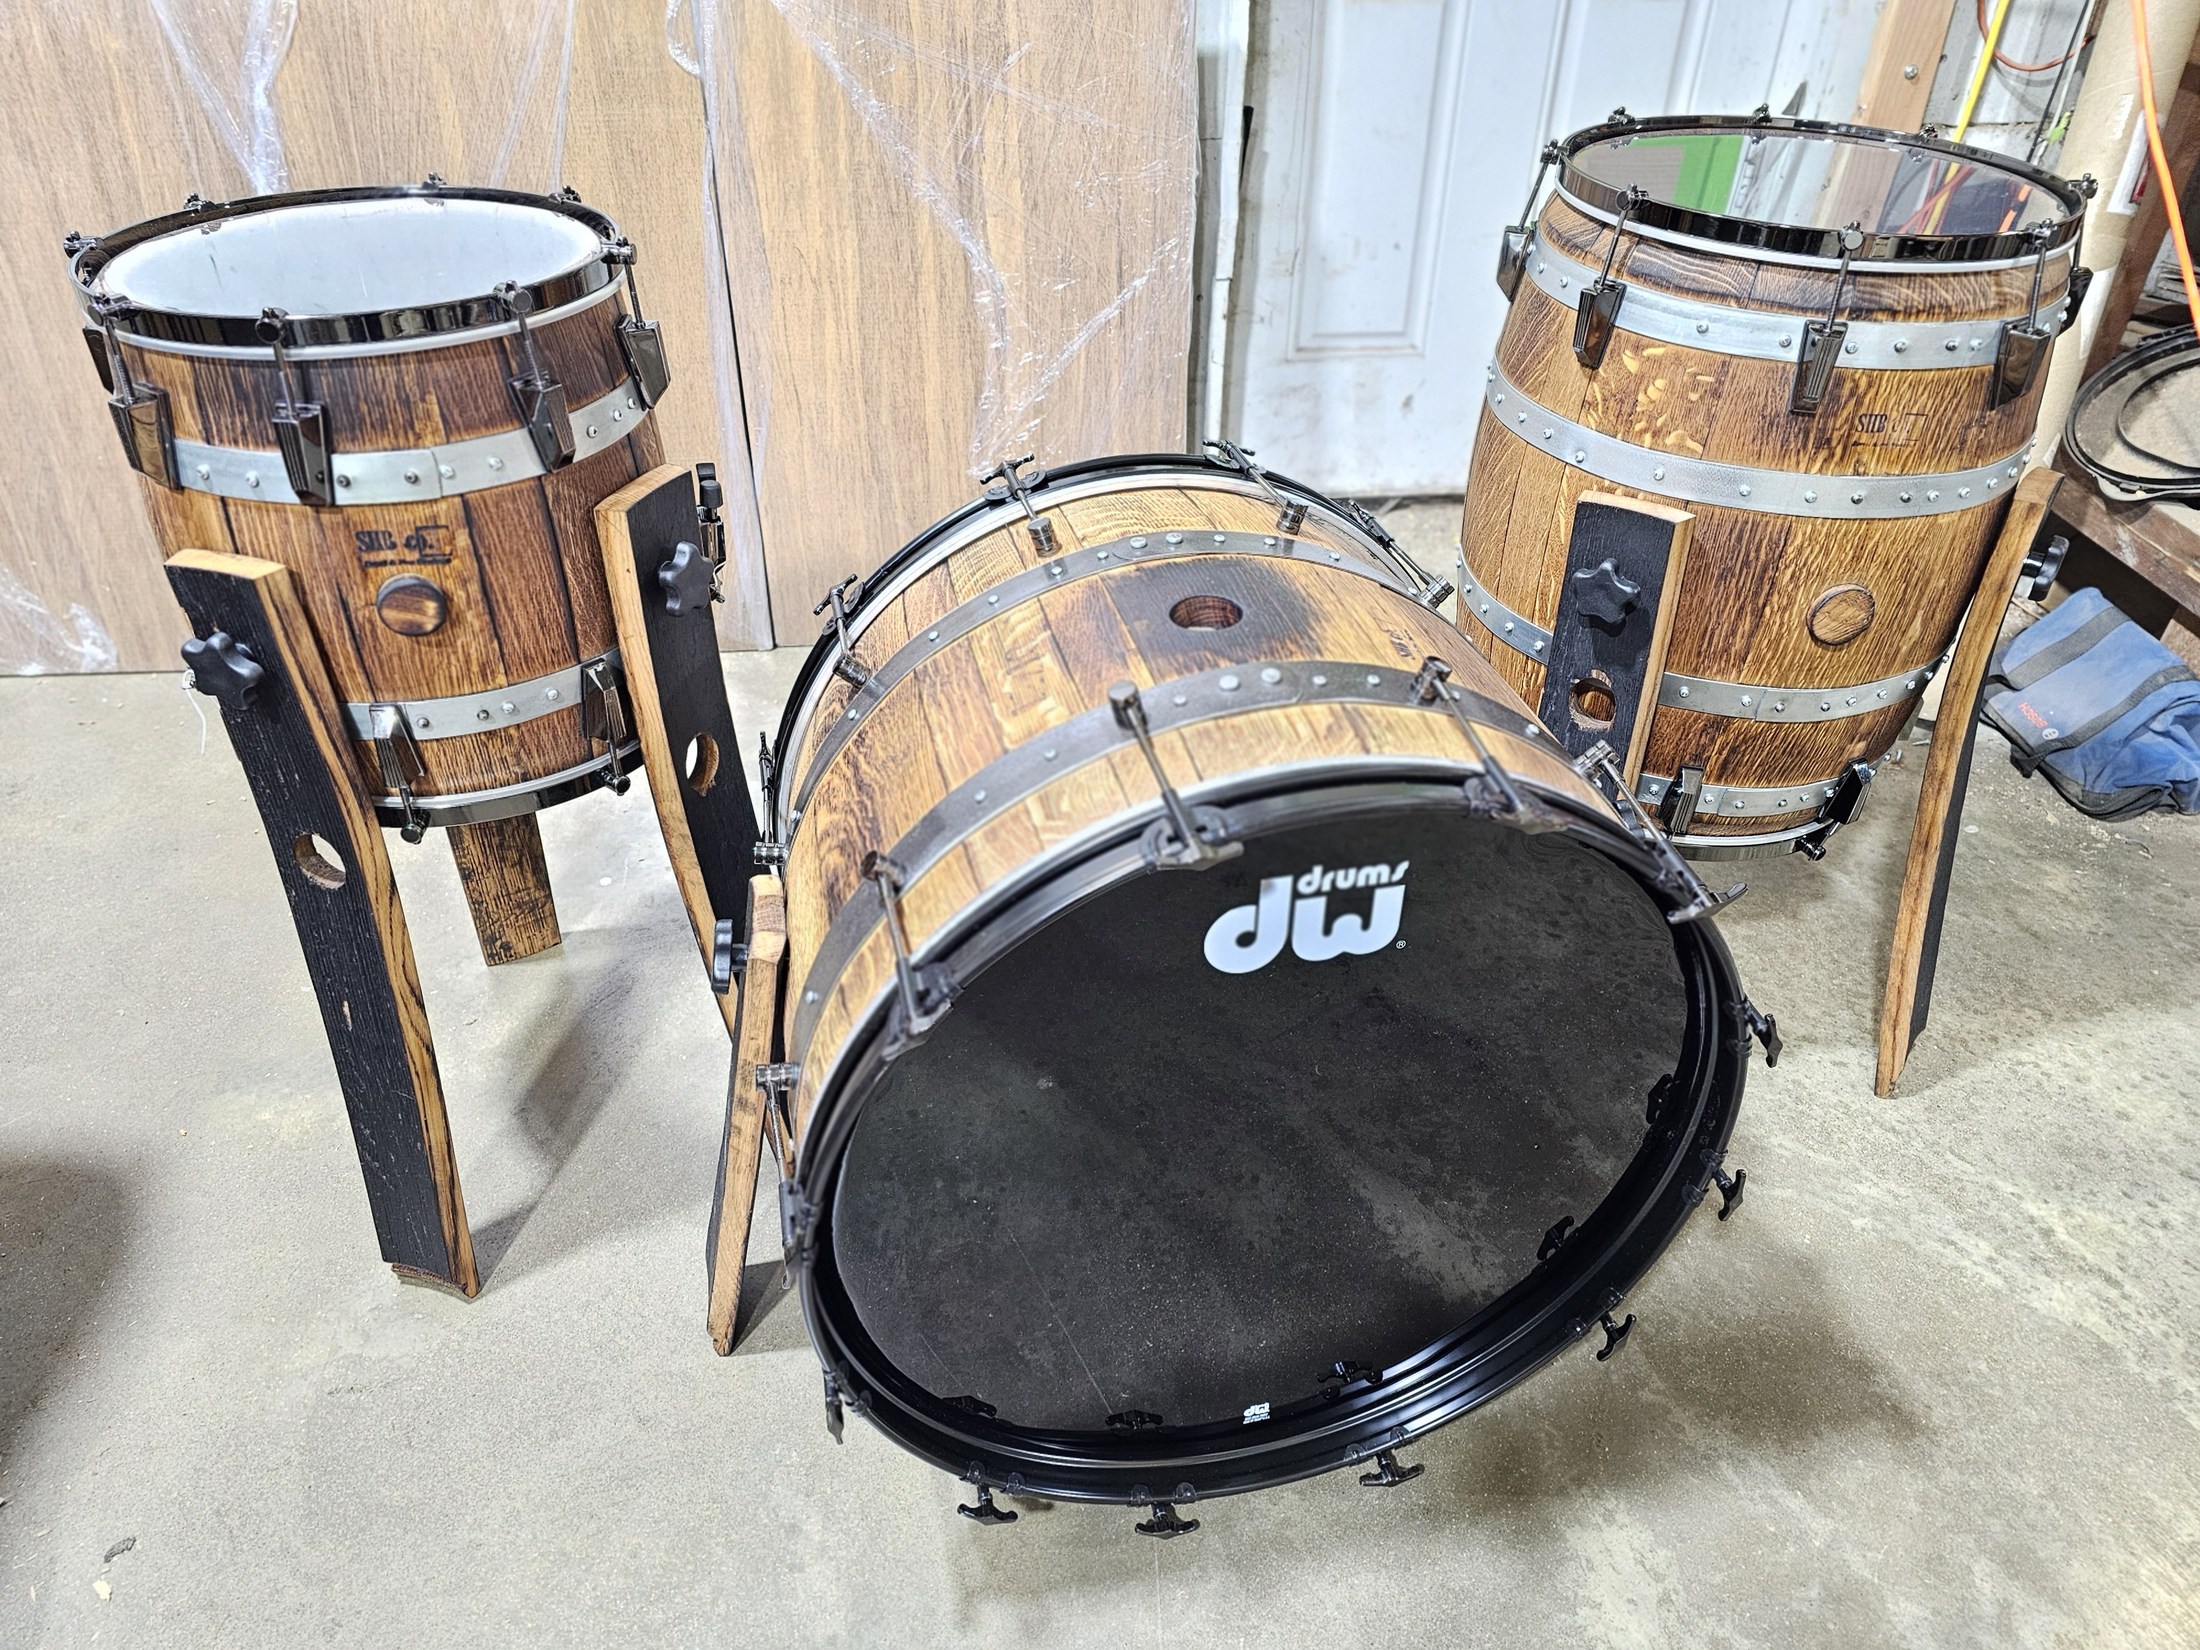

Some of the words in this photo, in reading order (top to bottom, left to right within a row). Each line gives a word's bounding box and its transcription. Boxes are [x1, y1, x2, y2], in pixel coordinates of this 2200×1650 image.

[2017, 702, 2048, 728] BOSCH
[1296, 860, 1410, 895] drums
[1203, 875, 1406, 974] dw
